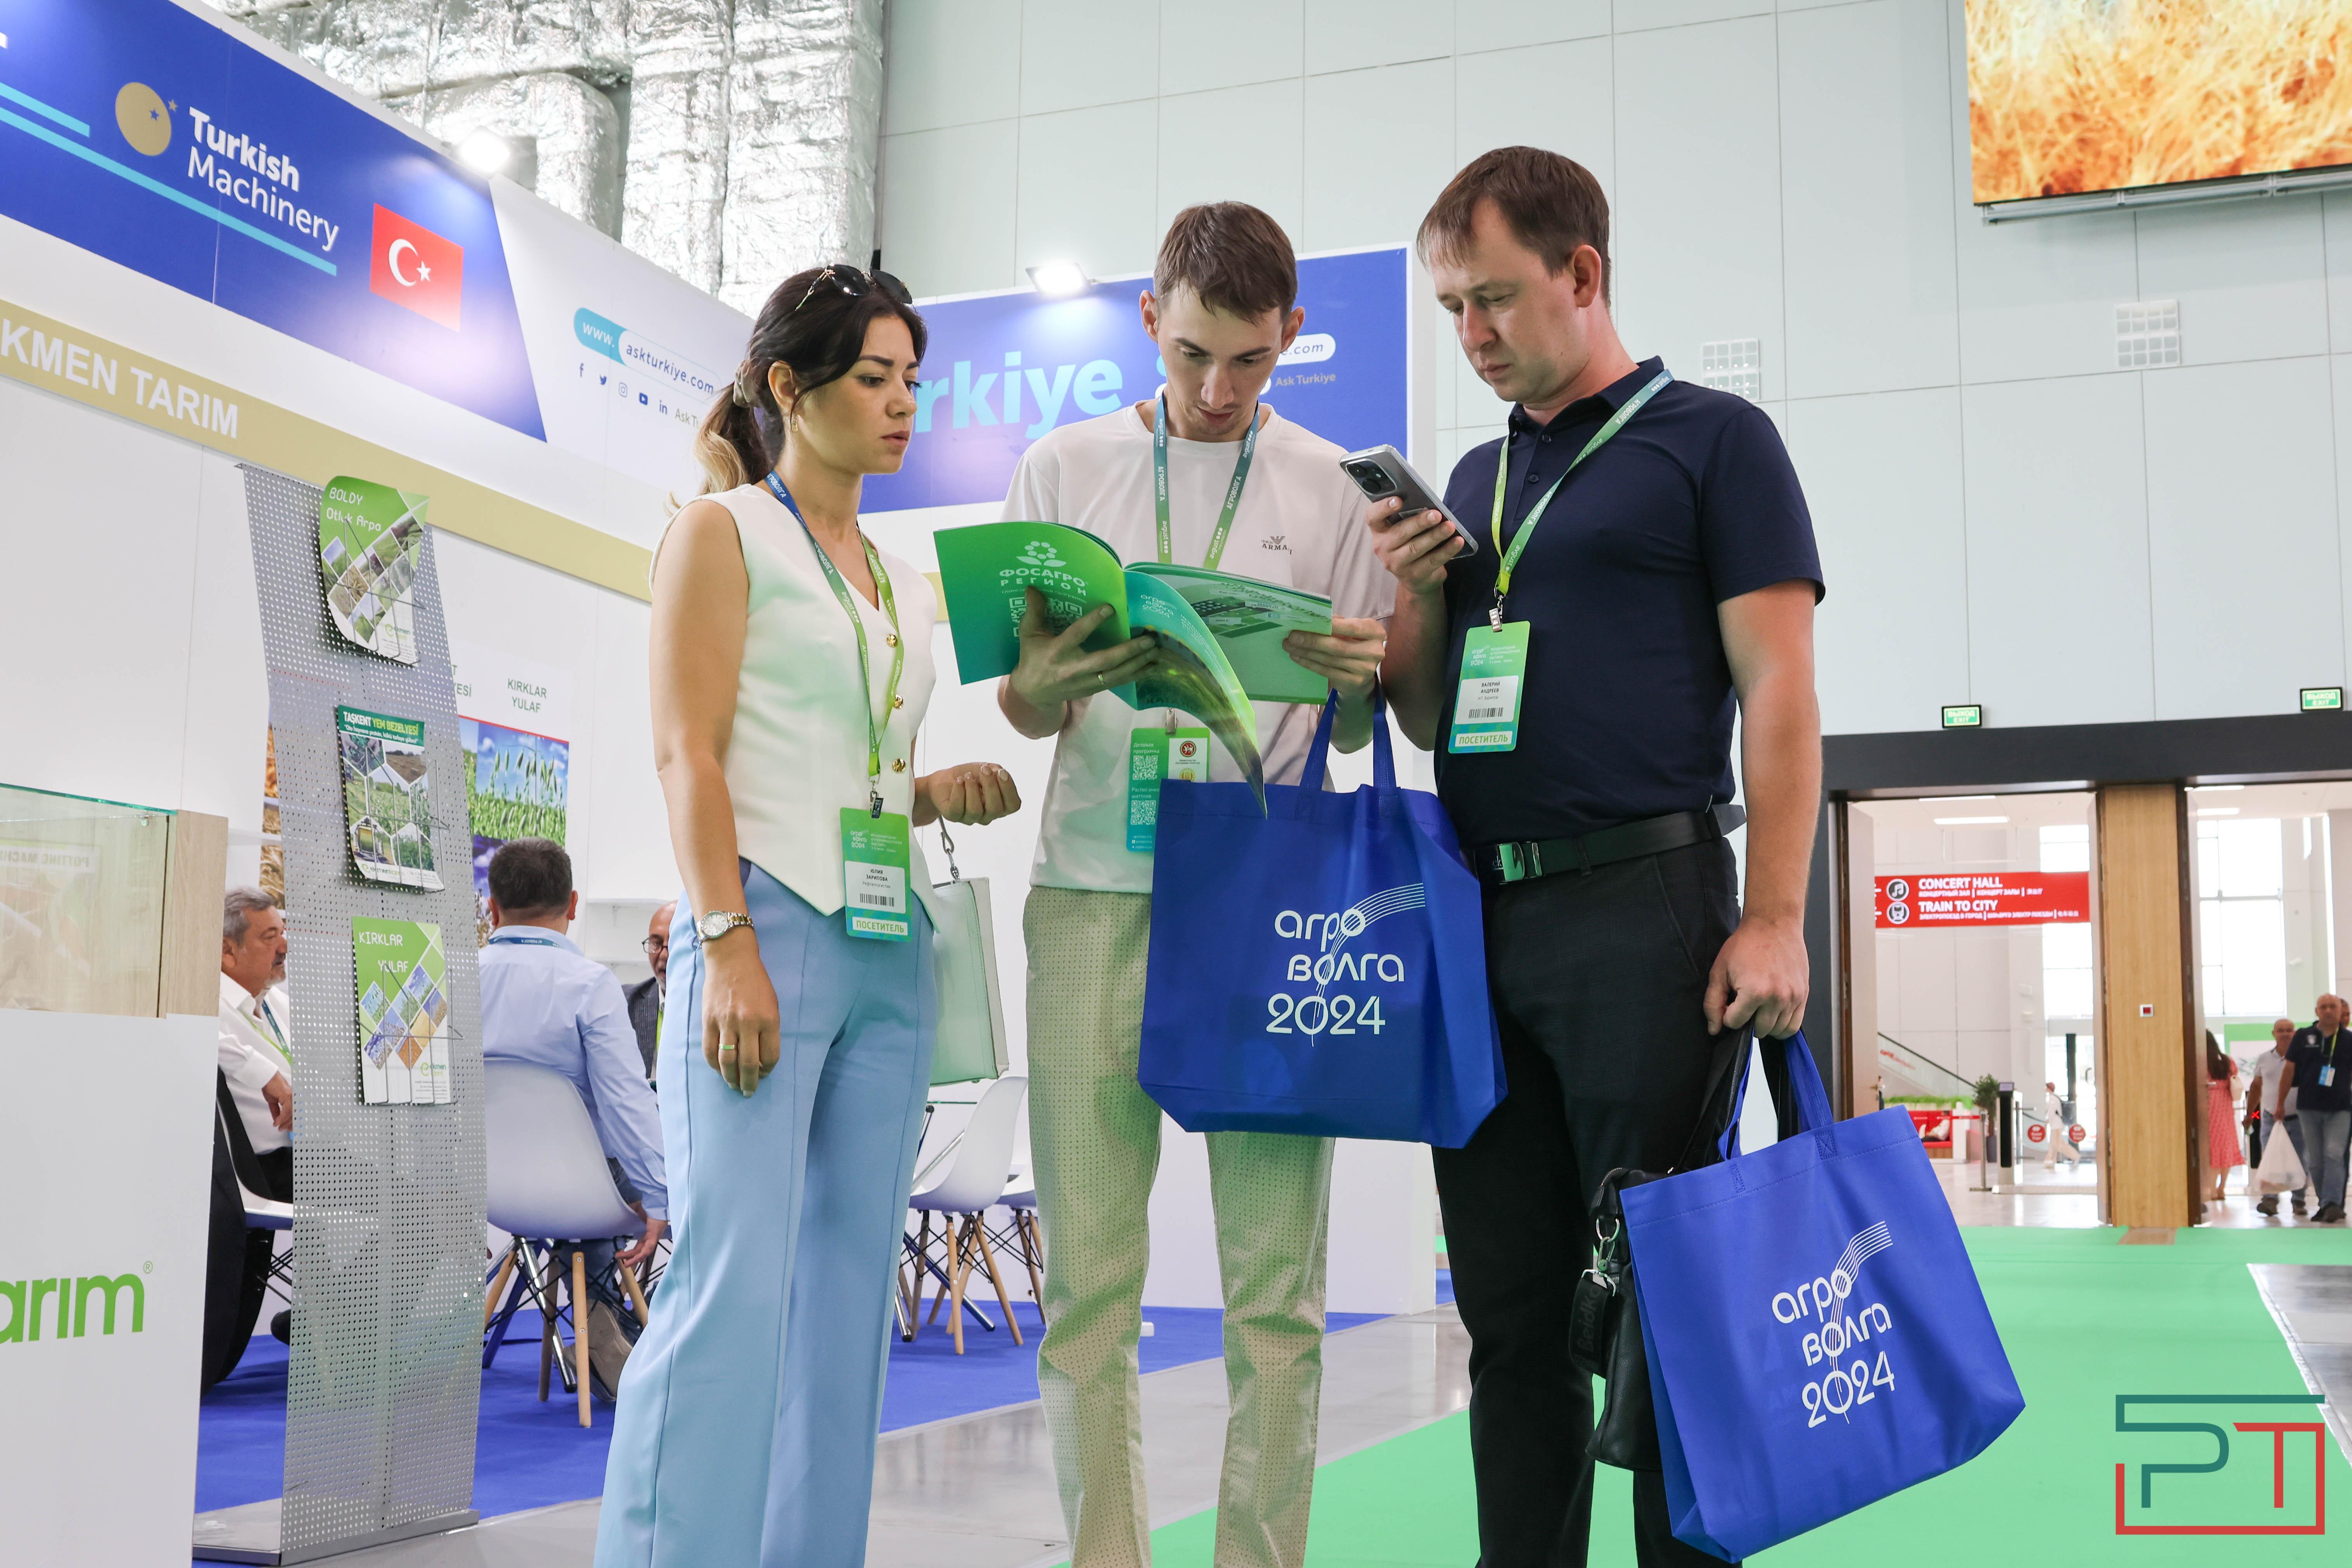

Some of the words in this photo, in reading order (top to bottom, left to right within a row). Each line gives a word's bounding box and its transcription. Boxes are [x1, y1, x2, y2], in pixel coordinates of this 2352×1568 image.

[189, 105, 299, 192] Turkish
[188, 147, 339, 252] Machinery
[626, 344, 714, 395] askturkiye.com
[1276, 376, 1294, 387] Ask
[1296, 373, 1336, 385] Turkiye
[131, 367, 238, 439] TARIM
[1615, 399, 1641, 425] АГРОВОЛГА
[675, 408, 689, 425] Ask
[329, 487, 363, 505] BOLDY
[1226, 476, 1242, 510] АГРОВОЛГА
[357, 515, 381, 532] Arpa
[1262, 543, 1292, 555] ARMAI
[999, 568, 1085, 587] ФОСАГРО
[1000, 577, 1086, 596] РЕГИОН
[508, 678, 546, 698] KIRKLAR
[512, 696, 541, 713] YULAF
[343, 711, 371, 727] TAŞKENT
[372, 718, 386, 729] YEM
[1459, 735, 1508, 744] ПОСЕТИТЕЛЬ
[1918, 877, 1971, 890] CONCERT
[1972, 876, 2003, 888] HALL
[1918, 900, 1953, 913] TRAIN
[1954, 900, 1971, 912] TO
[1972, 899, 1998, 911] CITY
[856, 920, 904, 933] ПОСЕТИТЕЛЬ
[1274, 908, 1366, 952] агро
[359, 932, 403, 946] KIRKLAR
[378, 960, 408, 973] YULAF
[1287, 952, 1404, 985] волга
[1266, 993, 1385, 1034] 2024
[1772, 1269, 1852, 1323] агро
[1802, 1303, 1892, 1366] волга
[1802, 1350, 1895, 1428] 2024
